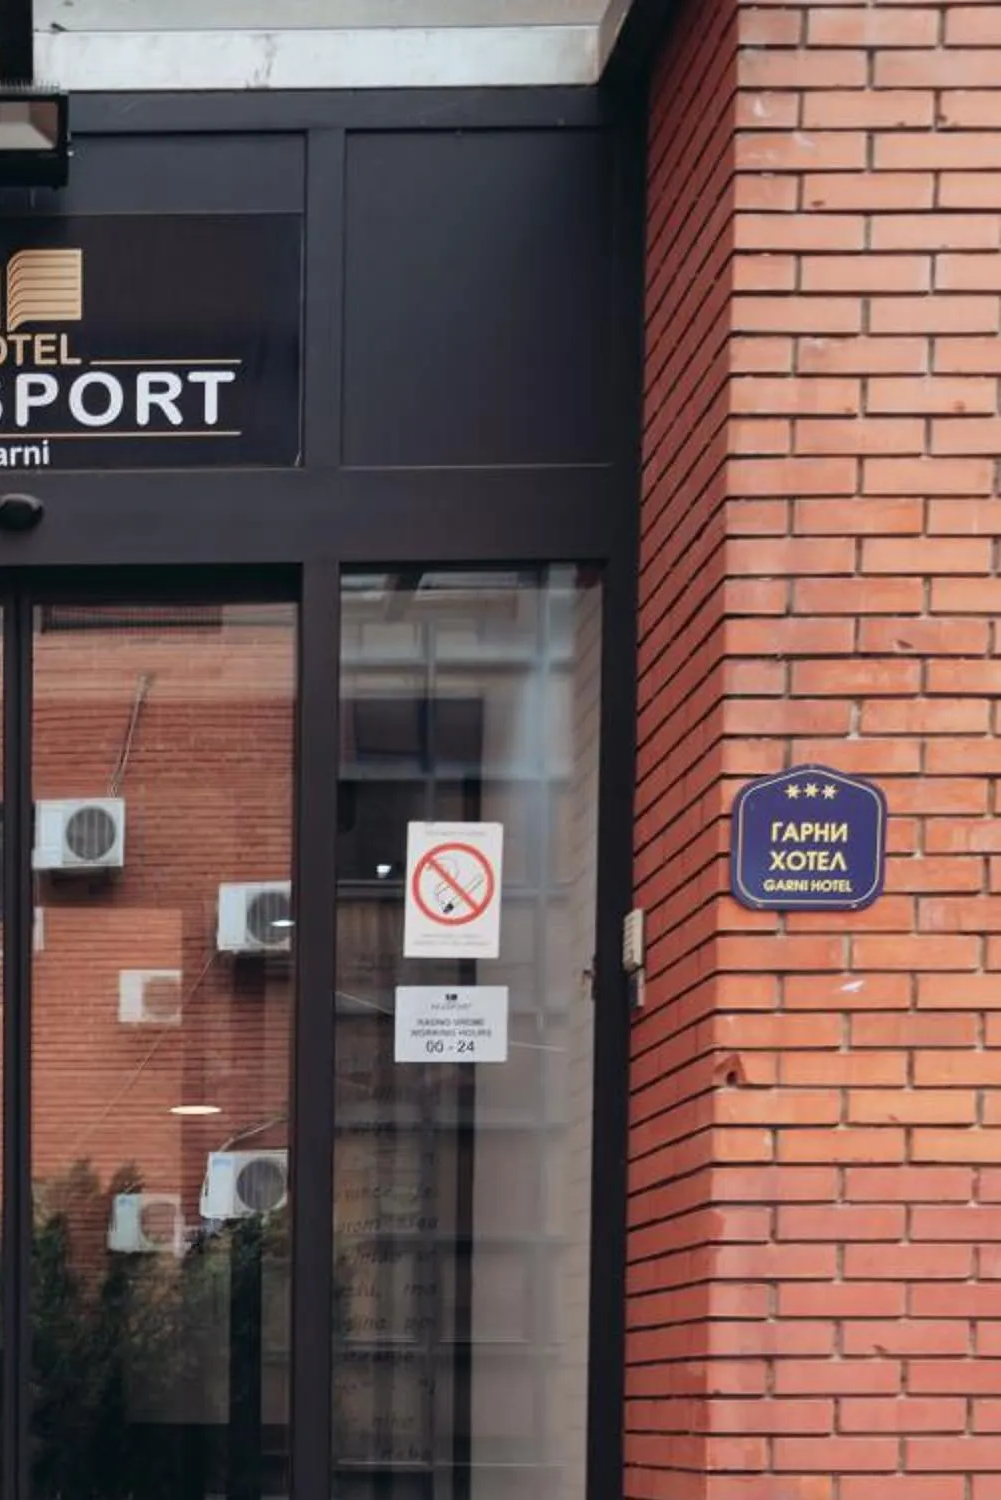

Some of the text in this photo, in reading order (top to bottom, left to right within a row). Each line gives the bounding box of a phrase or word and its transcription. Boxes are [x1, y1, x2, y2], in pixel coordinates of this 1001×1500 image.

[770, 821, 849, 843] ГАРНИ
[768, 850, 848, 872] ХОТЕЛ
[763, 879, 853, 893] GARNI HOTEL
[456, 1039, 475, 1053] 24
